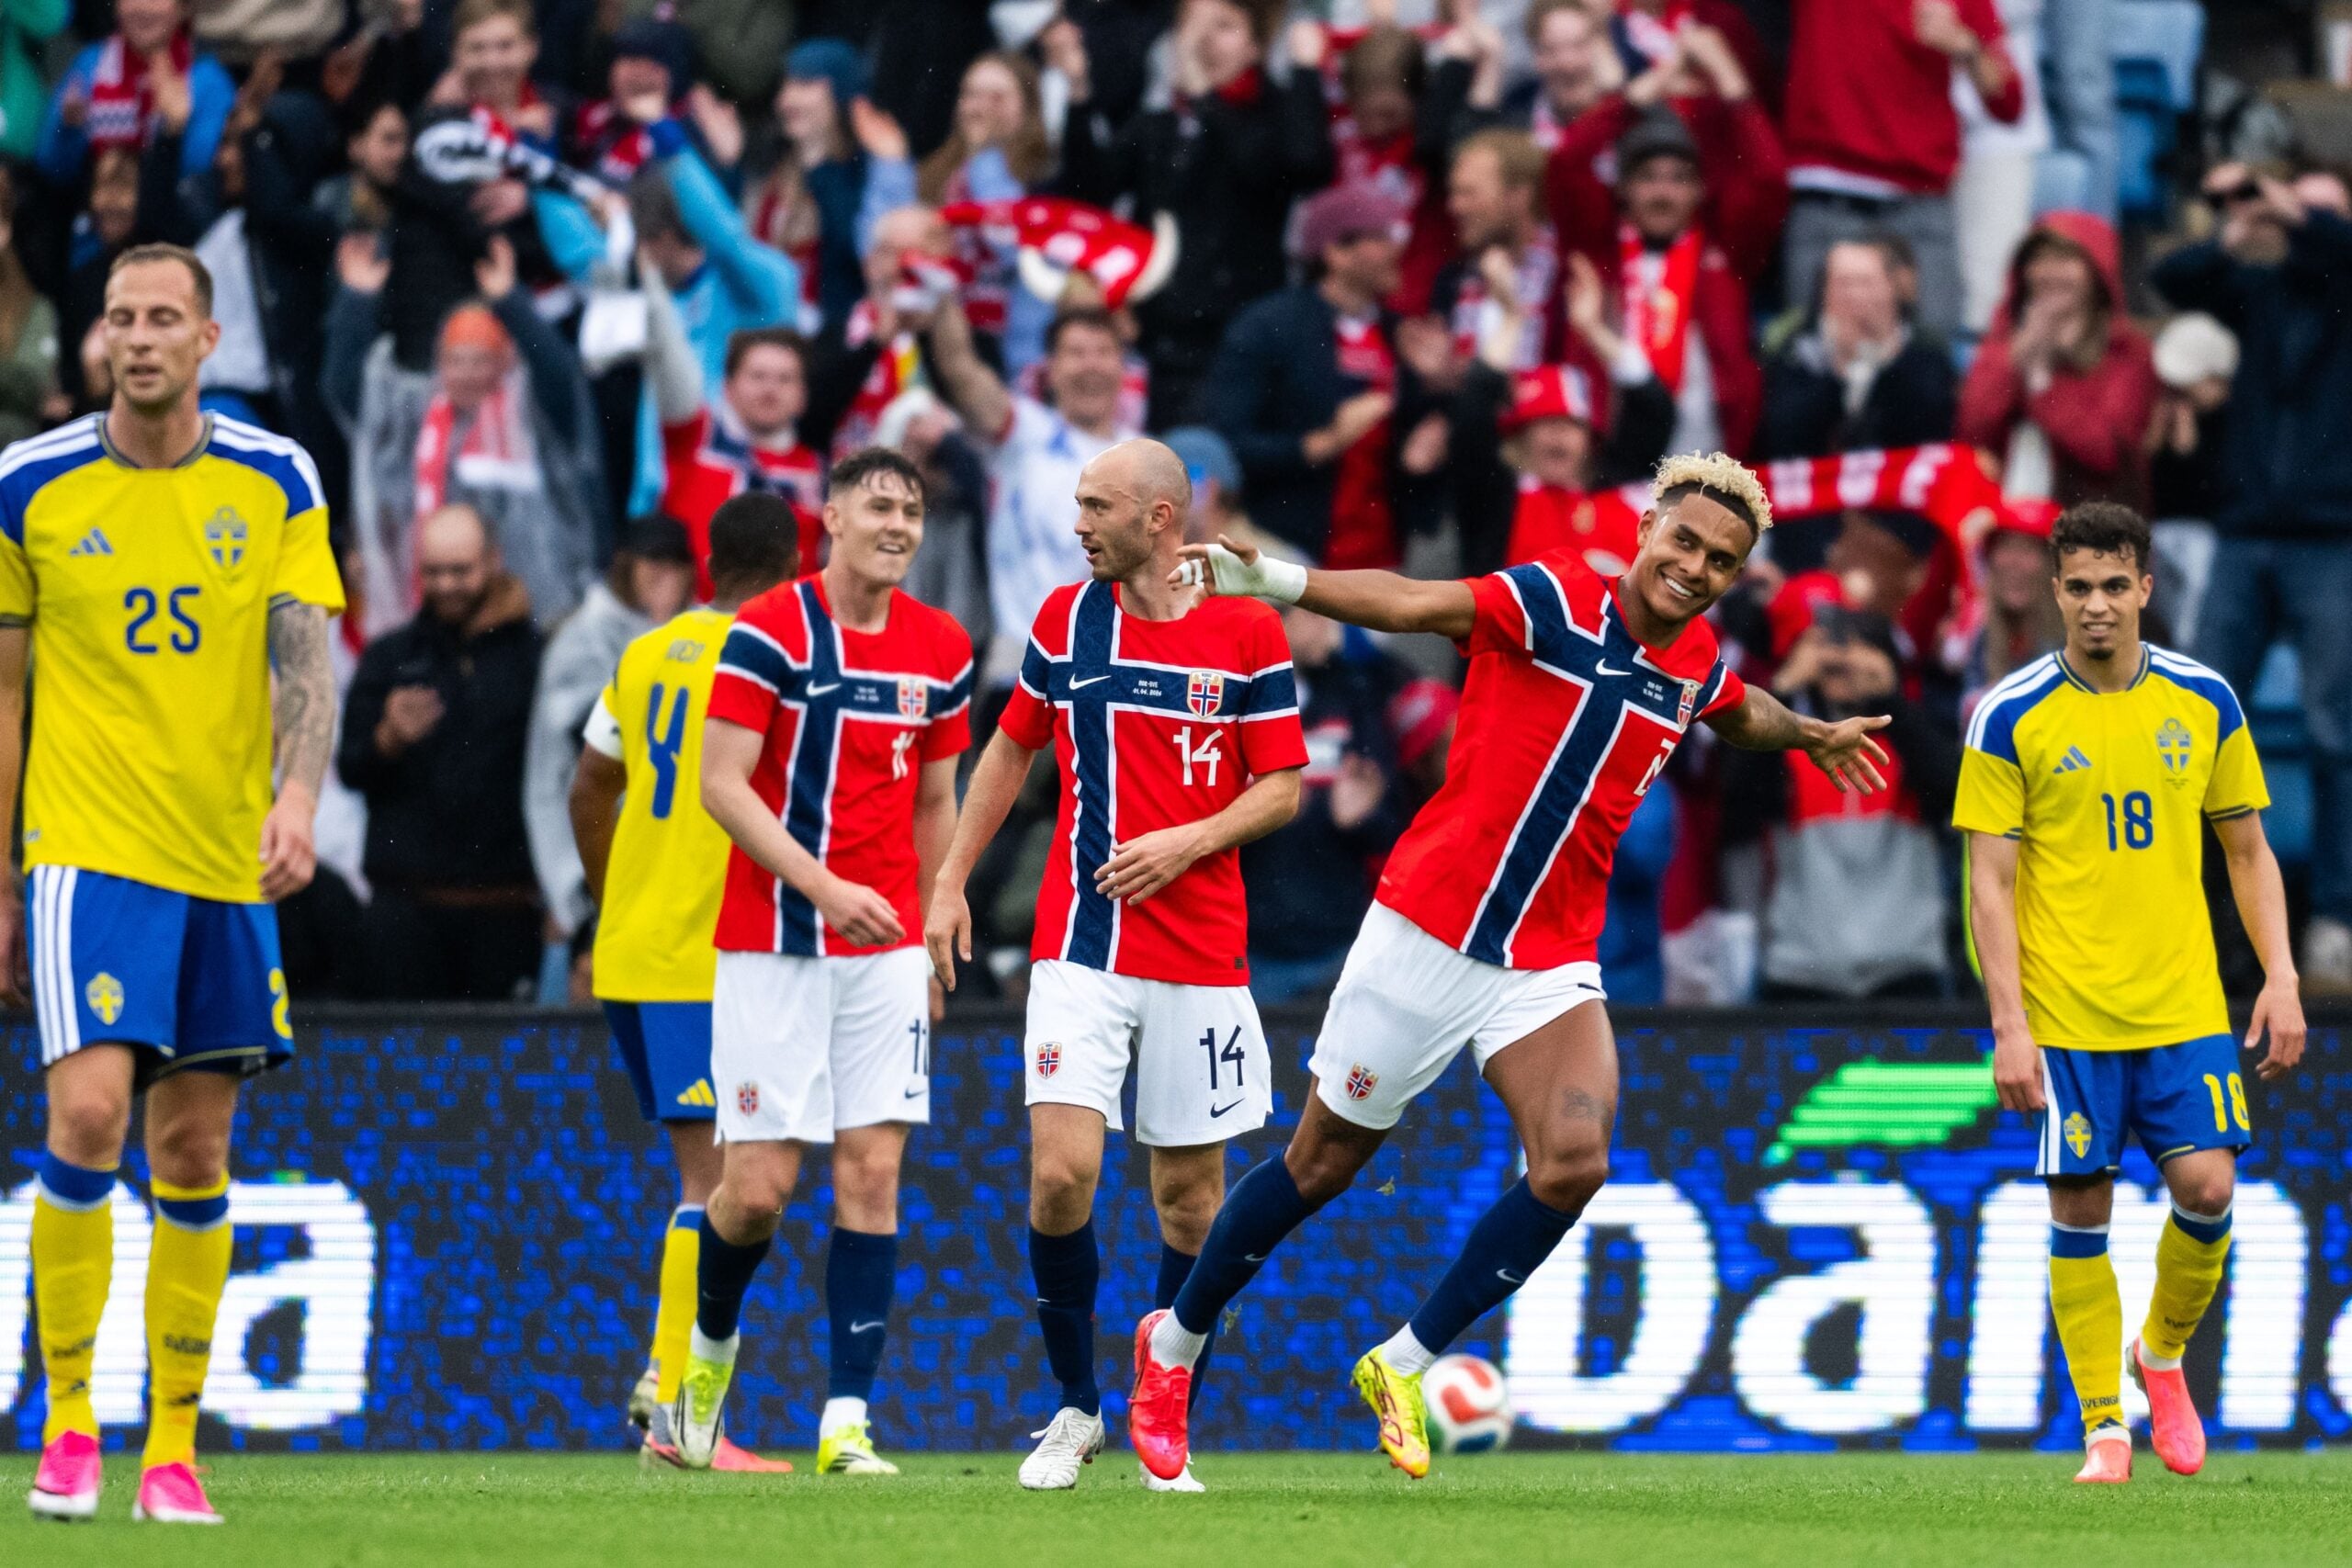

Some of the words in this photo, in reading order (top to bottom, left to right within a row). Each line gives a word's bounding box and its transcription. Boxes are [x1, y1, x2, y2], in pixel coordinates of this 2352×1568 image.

[125, 587, 200, 653] 25
[647, 682, 689, 819] 4
[892, 730, 916, 781] 11
[1173, 726, 1224, 786] 14
[2101, 791, 2154, 852] 18
[1199, 1024, 1245, 1089] 14
[2203, 1072, 2251, 1133] 18
